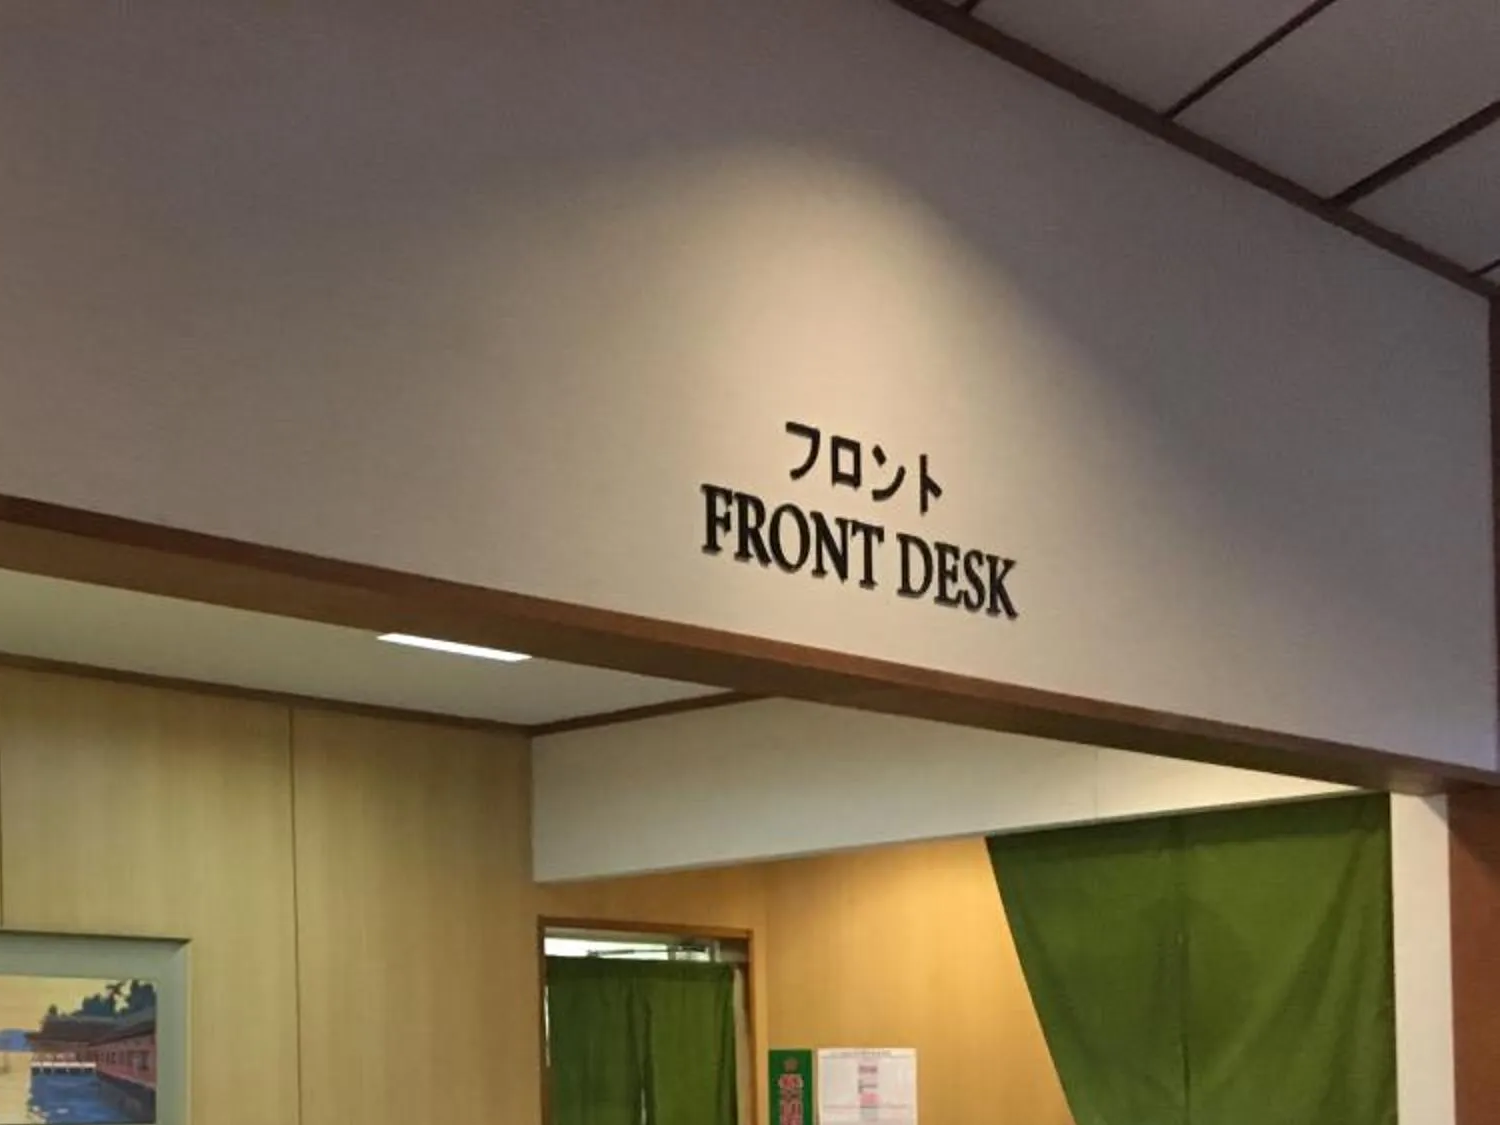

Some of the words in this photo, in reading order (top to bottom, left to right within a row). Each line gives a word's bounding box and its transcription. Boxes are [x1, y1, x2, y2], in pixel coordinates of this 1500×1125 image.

[785, 421, 943, 515] フロント
[701, 483, 885, 589] FRONT
[896, 532, 1019, 620] DESK
